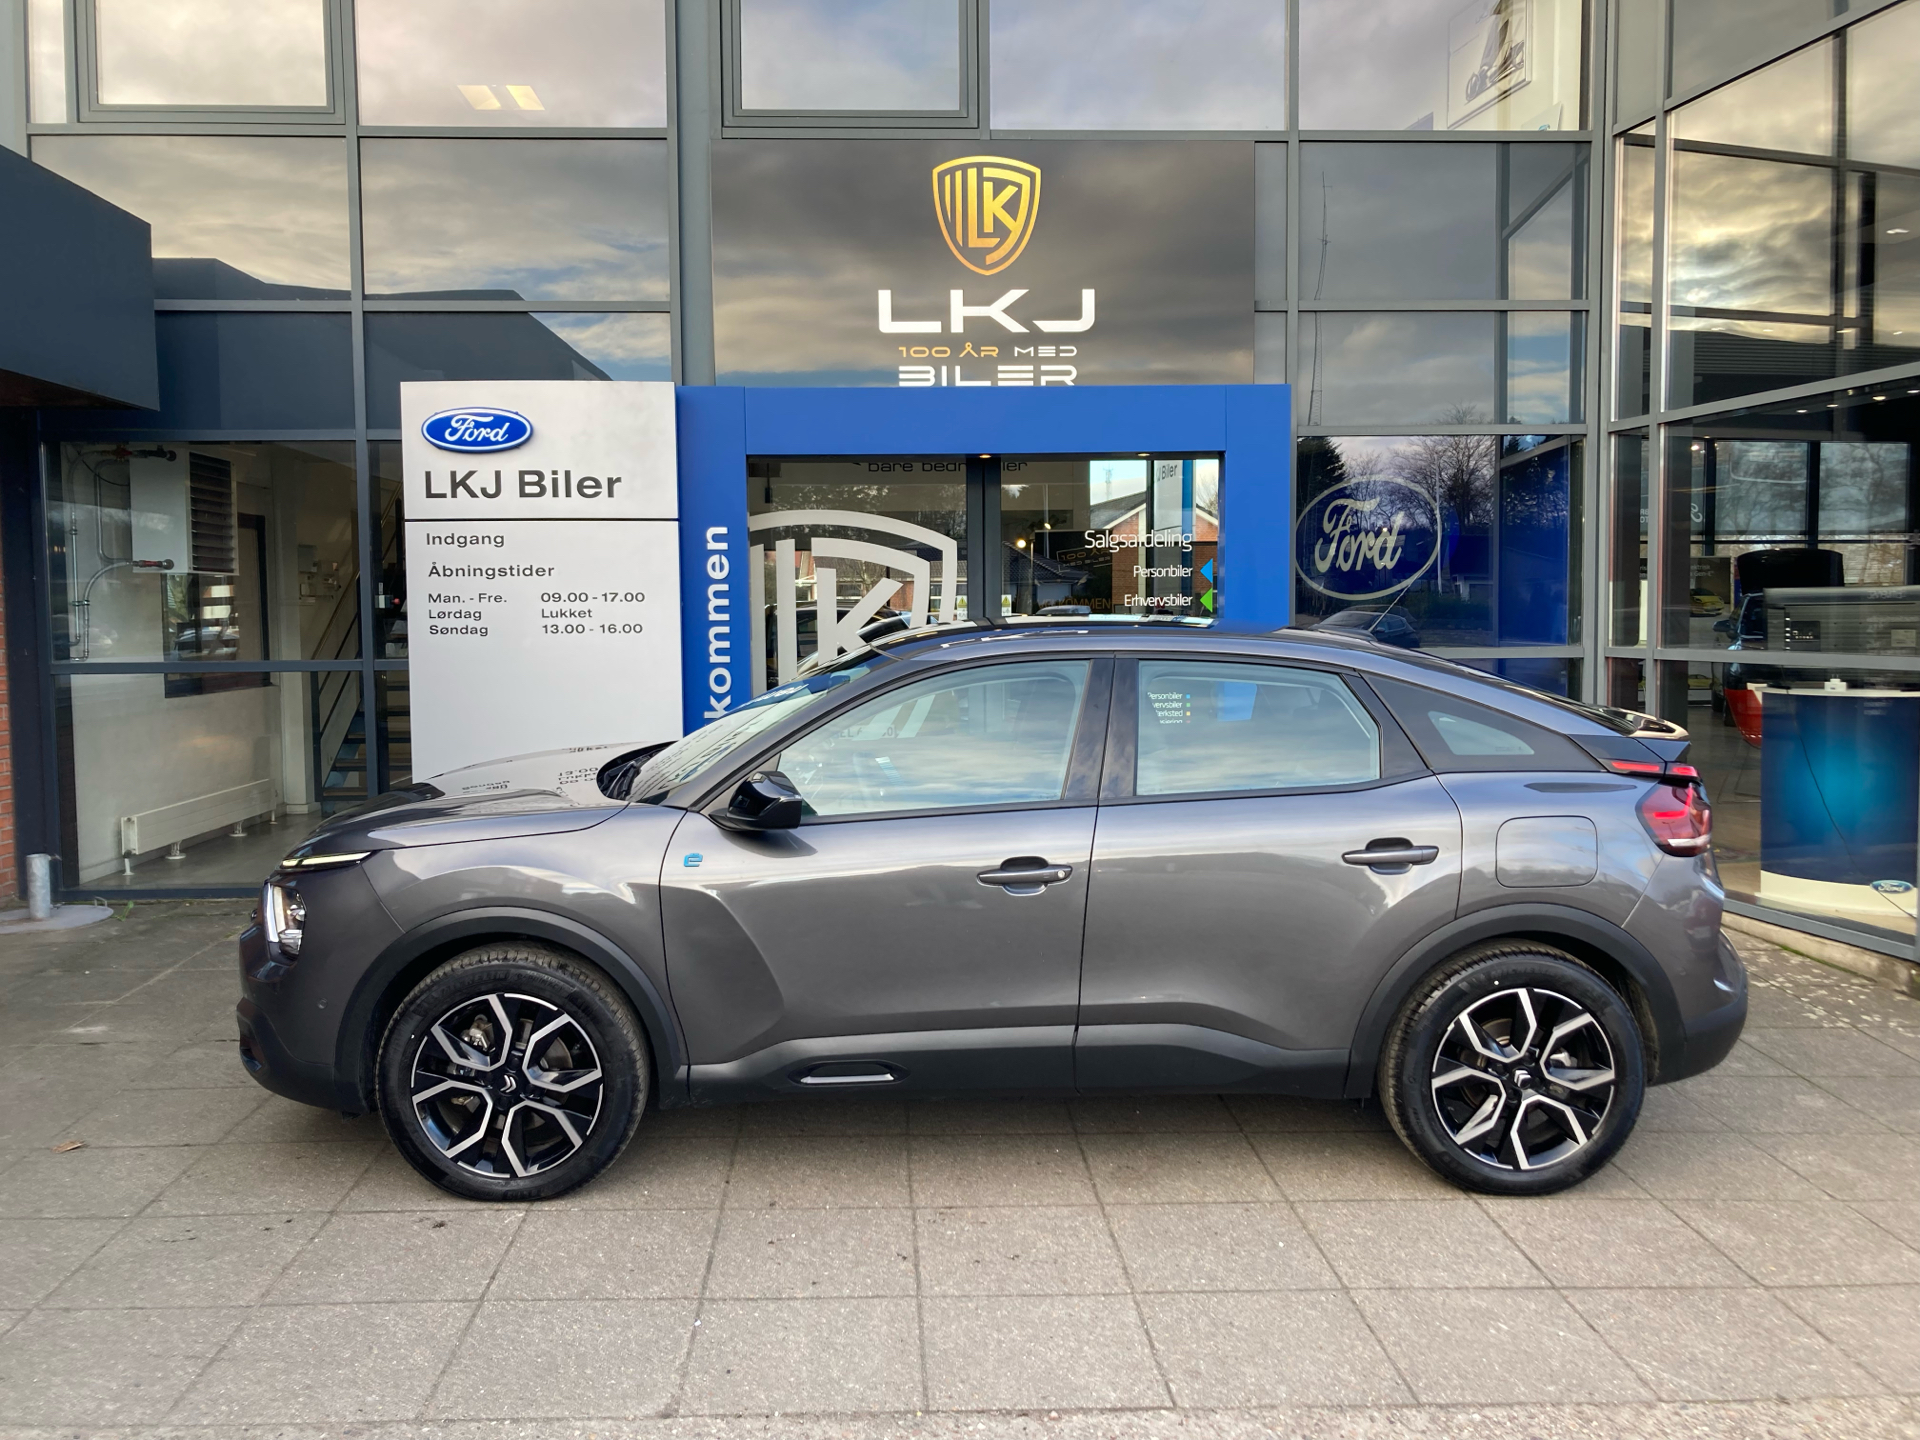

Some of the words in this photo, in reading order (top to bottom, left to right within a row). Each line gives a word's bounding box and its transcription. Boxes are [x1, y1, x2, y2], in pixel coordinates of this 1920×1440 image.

[878, 288, 1096, 333] LKJ
[898, 346, 950, 358] 100
[959, 341, 999, 358] ÅR
[1014, 345, 1077, 358] MED
[898, 365, 1077, 387] BILER
[444, 414, 511, 443] Ford
[424, 469, 501, 499] LKJ
[518, 469, 623, 499] Biler
[426, 532, 505, 549] Indgang
[1084, 529, 1194, 553] Salgsafdeling
[1314, 496, 1406, 573] Ford
[428, 562, 555, 580] Åbningstider
[1133, 565, 1194, 578] Personbiler
[428, 592, 466, 604] Man.
[478, 592, 508, 604] Fre.
[540, 592, 589, 603] 09.00
[601, 592, 646, 603] 17.00
[1124, 593, 1194, 607] Erhvervsbiler
[428, 608, 483, 622] Lørdag
[541, 608, 593, 619] Lukket
[703, 526, 733, 719] kommen
[429, 624, 489, 637] Søndag
[541, 624, 586, 635] 13.00
[599, 623, 643, 635] 16.00
